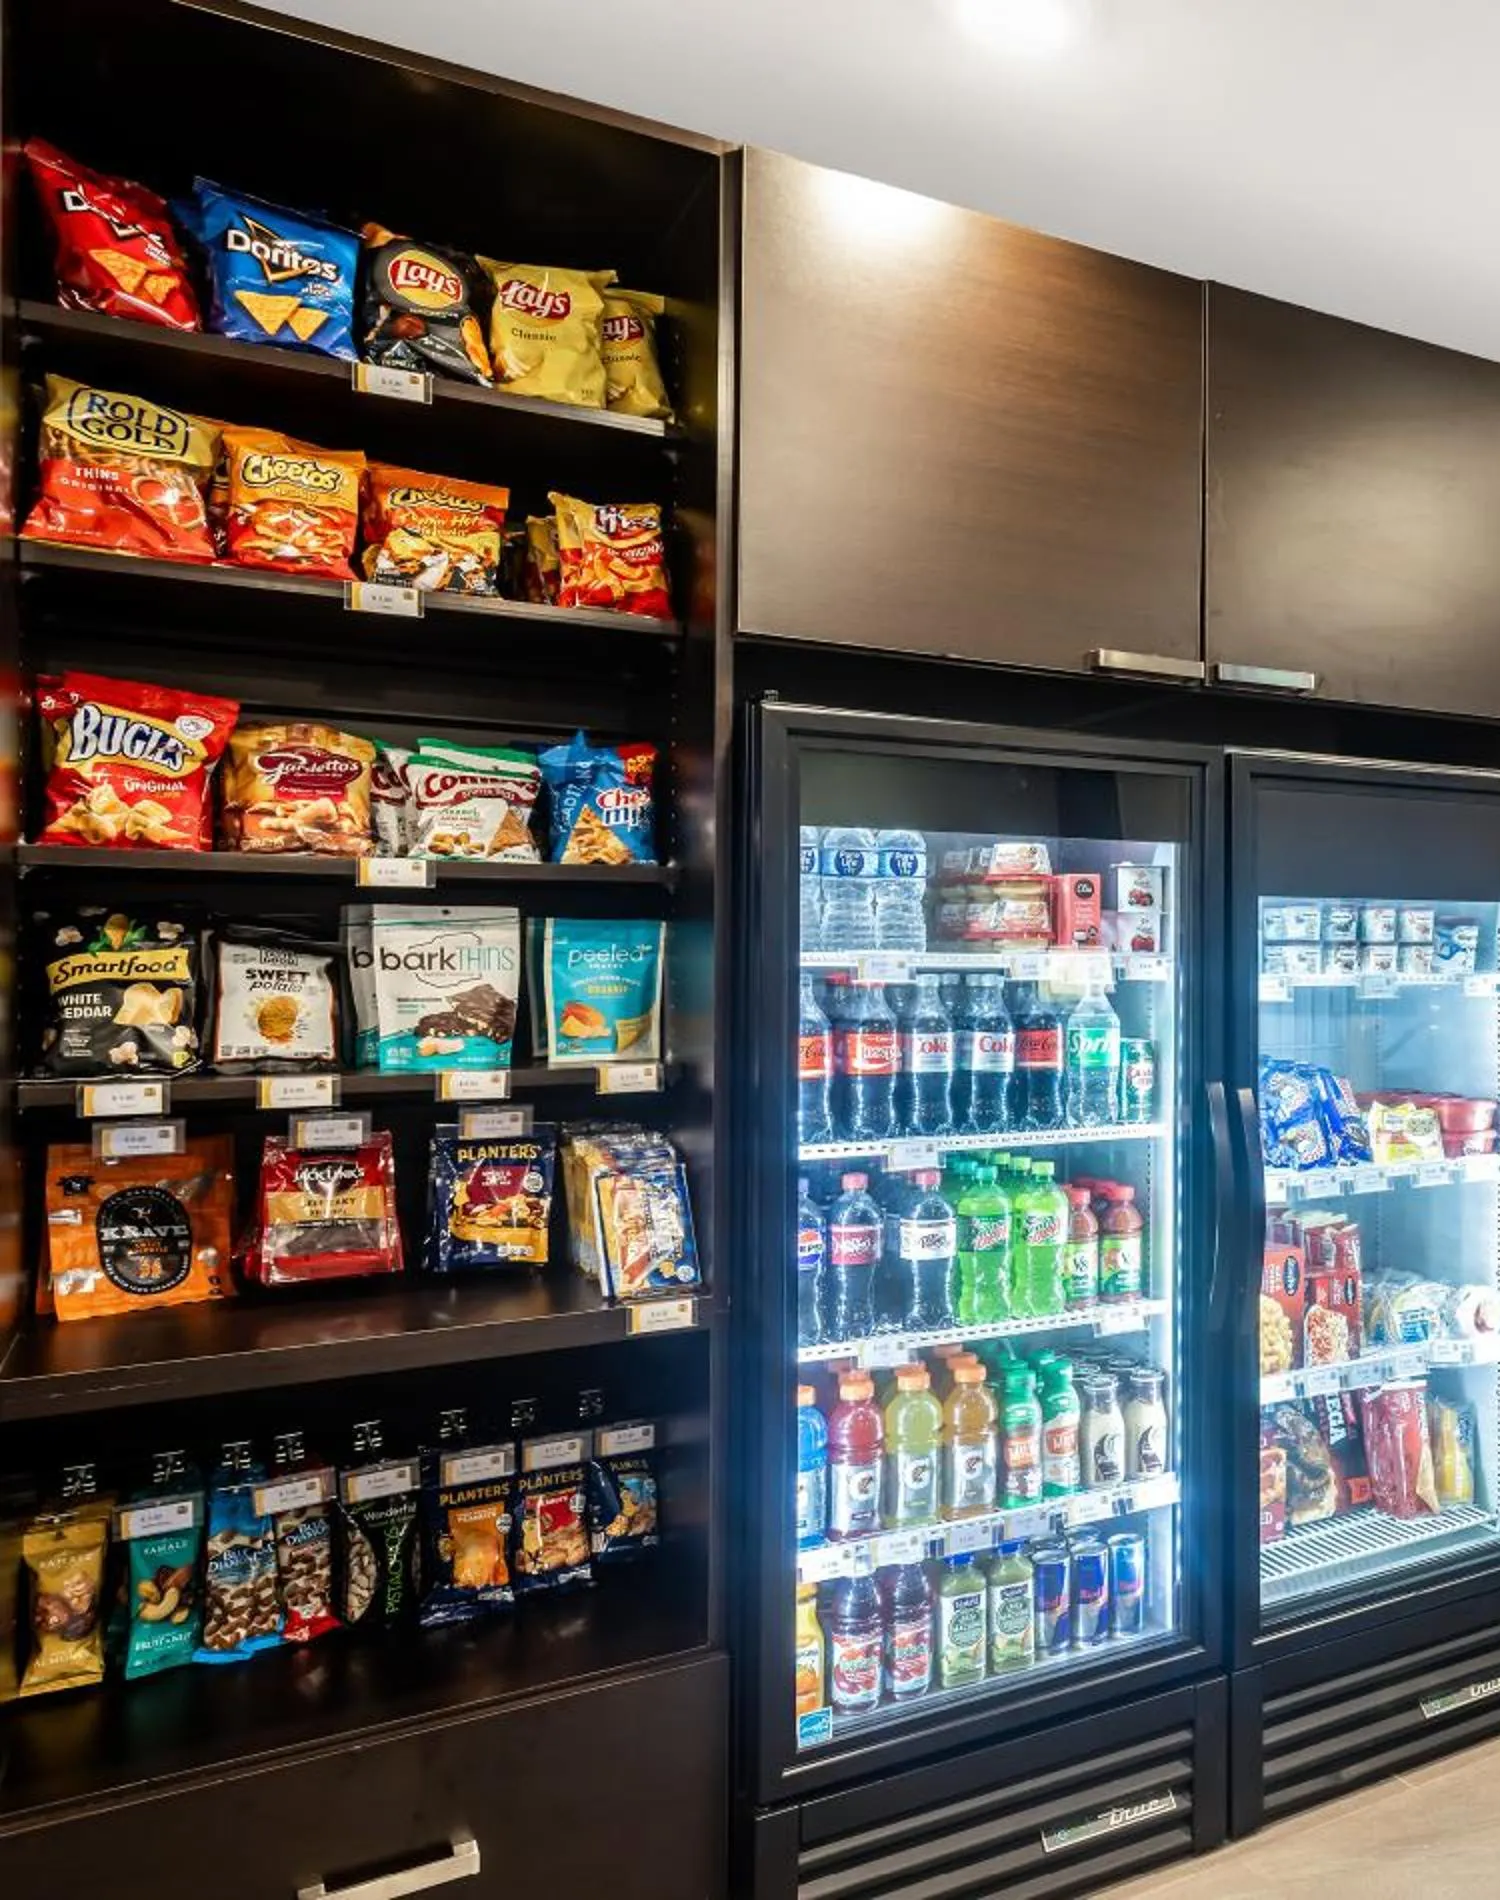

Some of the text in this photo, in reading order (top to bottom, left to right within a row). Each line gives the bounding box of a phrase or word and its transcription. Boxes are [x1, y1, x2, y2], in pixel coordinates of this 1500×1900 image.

[227, 229, 338, 281] Doritos
[87, 392, 179, 437] ROLD
[81, 418, 177, 452] GOLD
[242, 454, 341, 495] Cheetos
[68, 703, 194, 772] BUGLES
[53, 954, 178, 986] Smartfood
[457, 1143, 541, 1163] PLANTERS
[439, 1482, 511, 1507] PLANTERS
